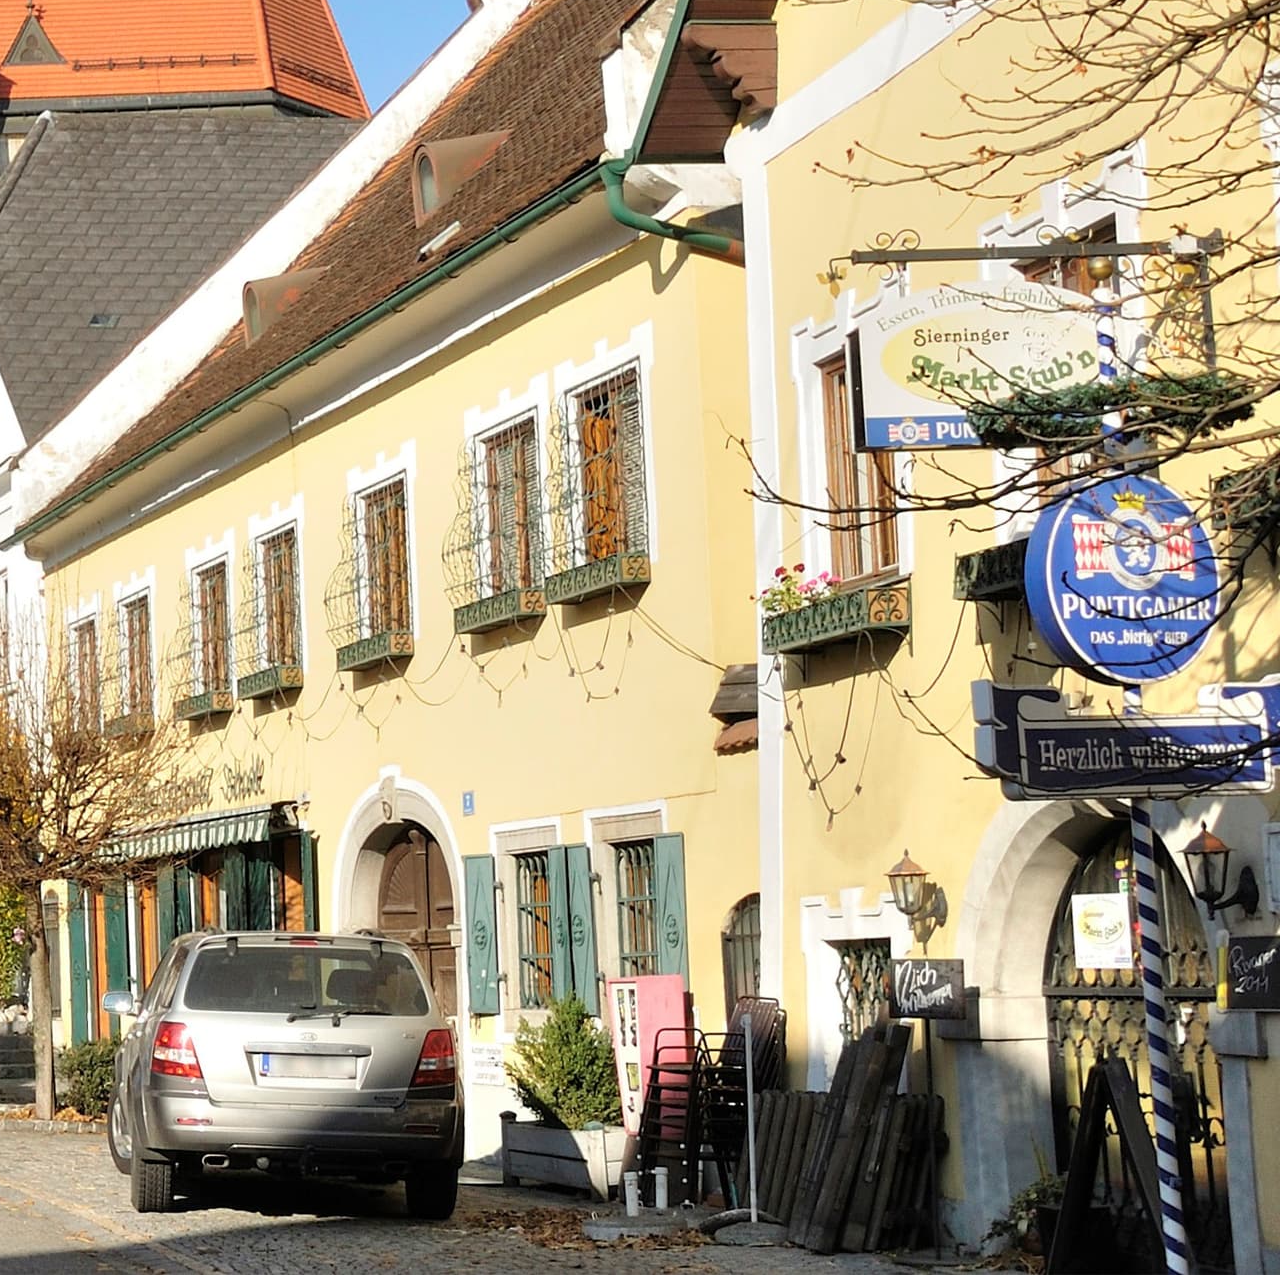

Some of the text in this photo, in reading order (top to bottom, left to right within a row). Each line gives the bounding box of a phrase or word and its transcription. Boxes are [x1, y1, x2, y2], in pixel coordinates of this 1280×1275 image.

[876, 304, 926, 333] Essen,
[913, 327, 1010, 347] Sierninger
[907, 354, 1000, 392] Markt
[1061, 593, 1212, 621] PUNTIGAMER
[1090, 630, 1116, 645] DAS
[1038, 737, 1122, 772] Herzlich
